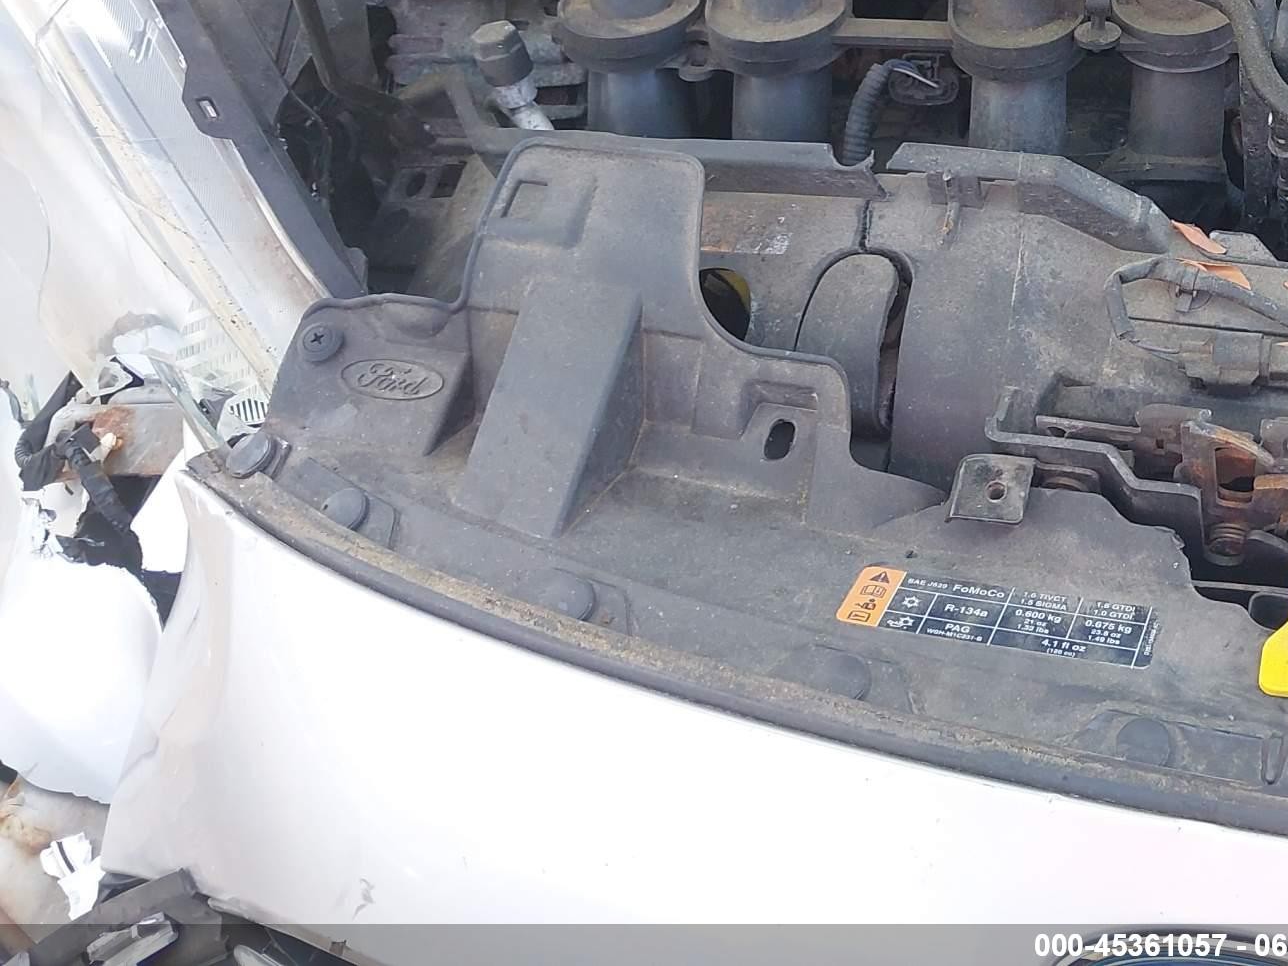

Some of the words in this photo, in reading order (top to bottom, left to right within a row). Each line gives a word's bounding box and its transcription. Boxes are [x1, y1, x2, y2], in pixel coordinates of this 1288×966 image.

[358, 363, 428, 395] Ford
[952, 584, 1004, 598] FoMoCo
[944, 603, 988, 617] R-134a
[1036, 600, 1066, 610] SIGMA
[1016, 609, 1046, 620] 0.600
[1048, 614, 1062, 623] kg
[945, 623, 970, 633] PAG
[1085, 620, 1115, 630] 0.675
[1118, 624, 1132, 634] kg
[1042, 639, 1058, 647] 4.1
[1072, 644, 1086, 652] oz
